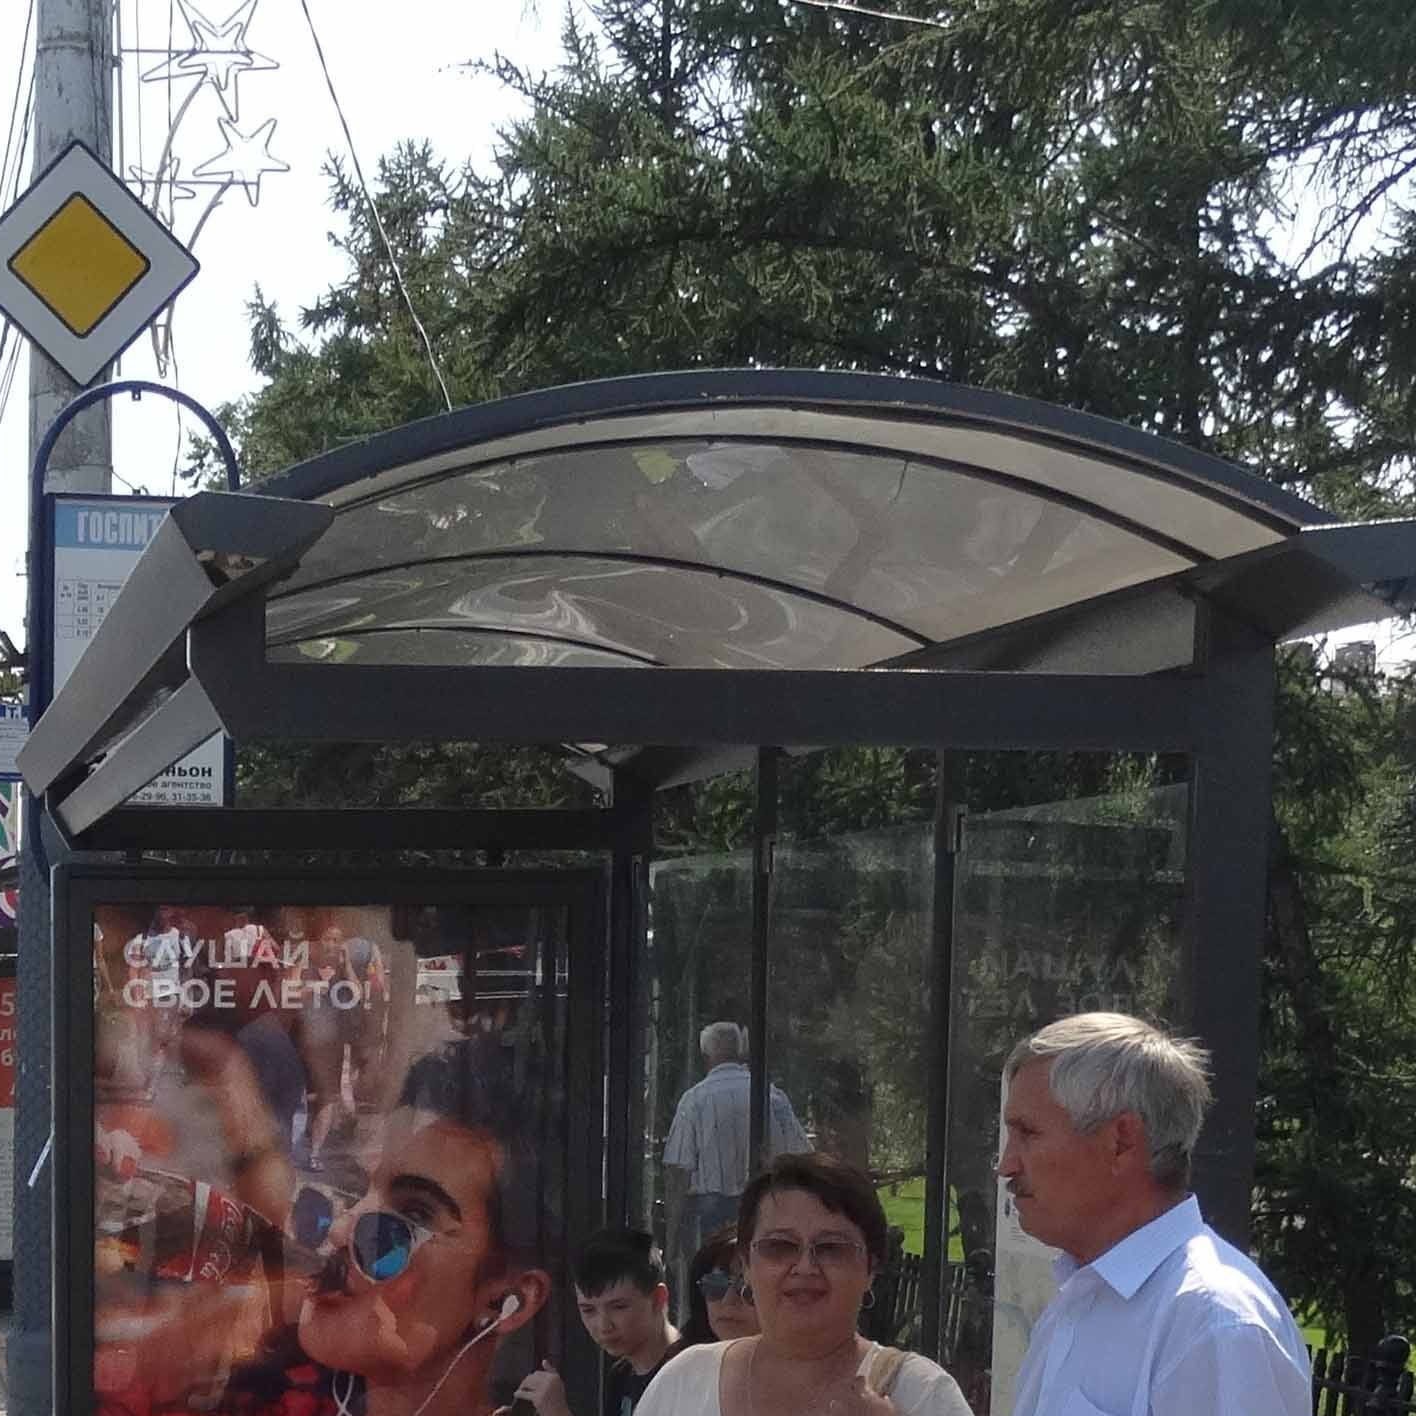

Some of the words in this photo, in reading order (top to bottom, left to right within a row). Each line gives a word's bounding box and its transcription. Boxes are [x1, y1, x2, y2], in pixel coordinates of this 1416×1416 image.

[77, 510, 164, 545] ГОСПИТ
[123, 924, 310, 969] СЛУШАЙ
[122, 978, 237, 1009] СВОЕ
[247, 978, 372, 1010] ЛЕТО!
